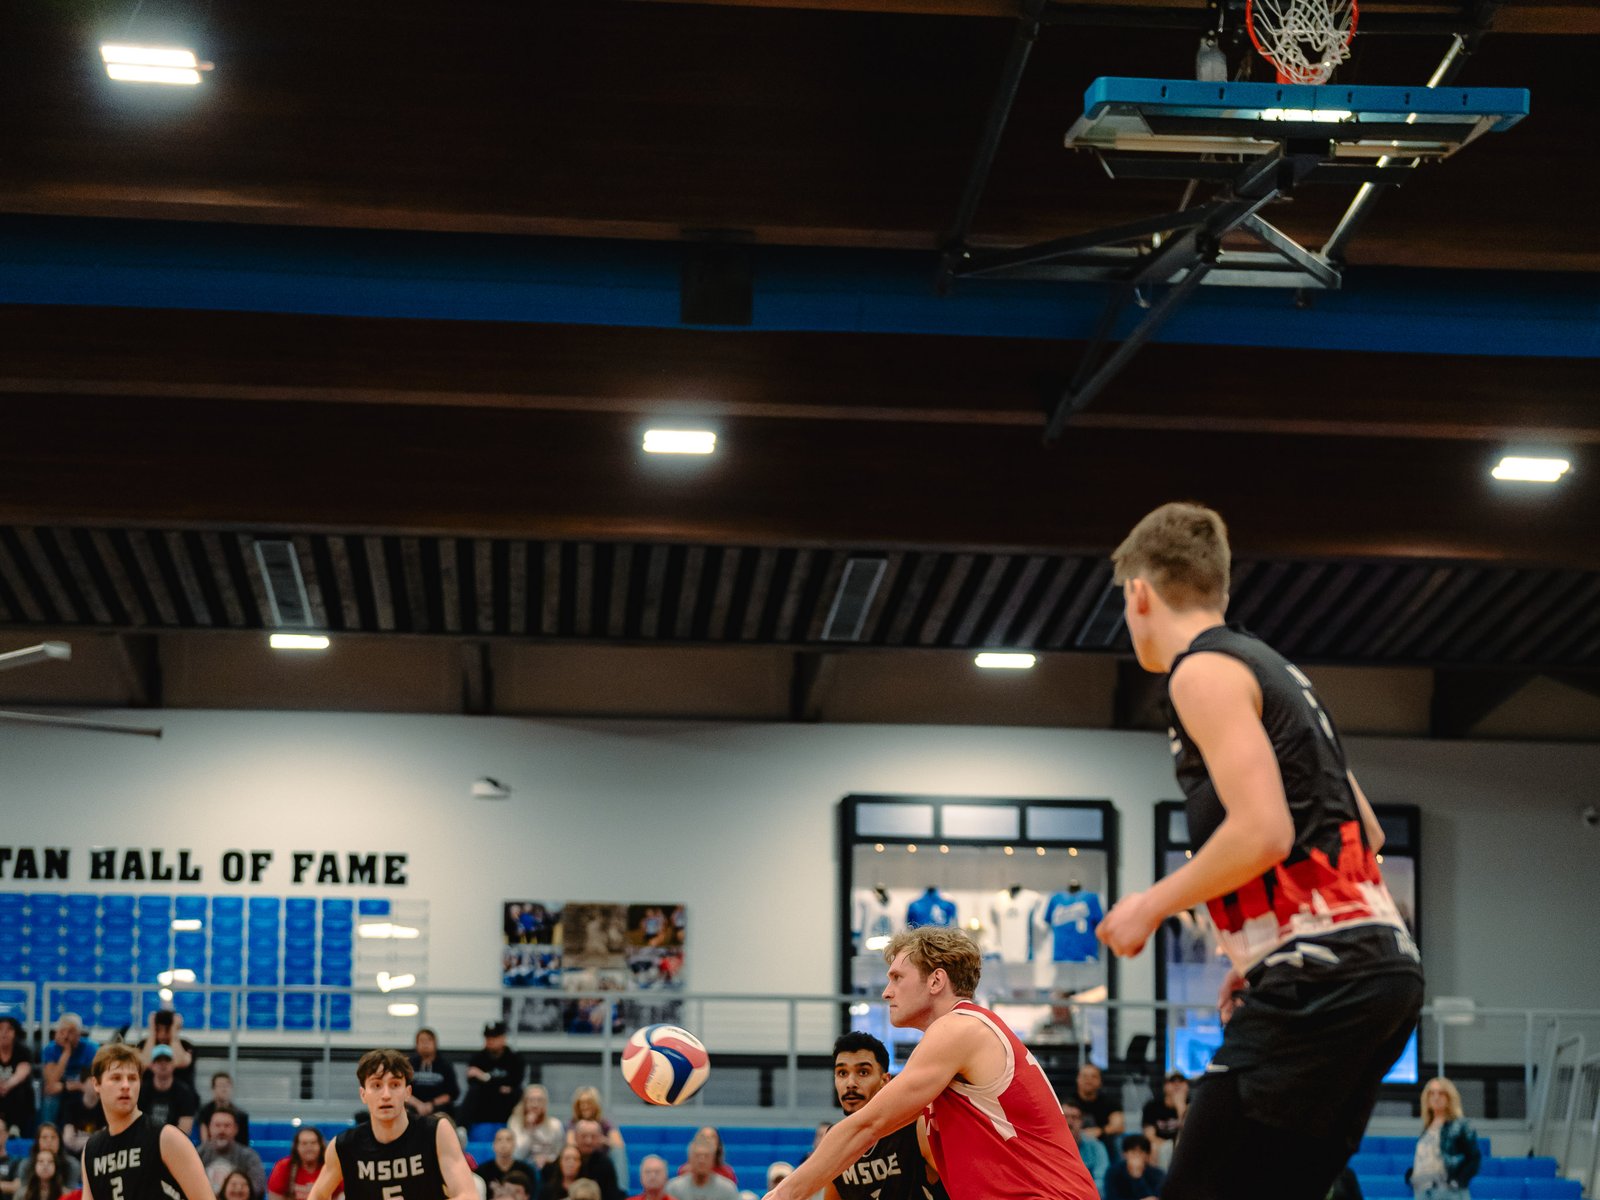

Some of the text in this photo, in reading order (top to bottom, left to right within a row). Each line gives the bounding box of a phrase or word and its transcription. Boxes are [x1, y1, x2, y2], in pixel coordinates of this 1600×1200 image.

[91, 850, 200, 881] HALL
[222, 851, 272, 882] OF
[293, 853, 406, 884] FAME
[93, 1147, 141, 1177] MSOE
[357, 1153, 425, 1181] MSOE
[842, 1152, 902, 1185] MSOE
